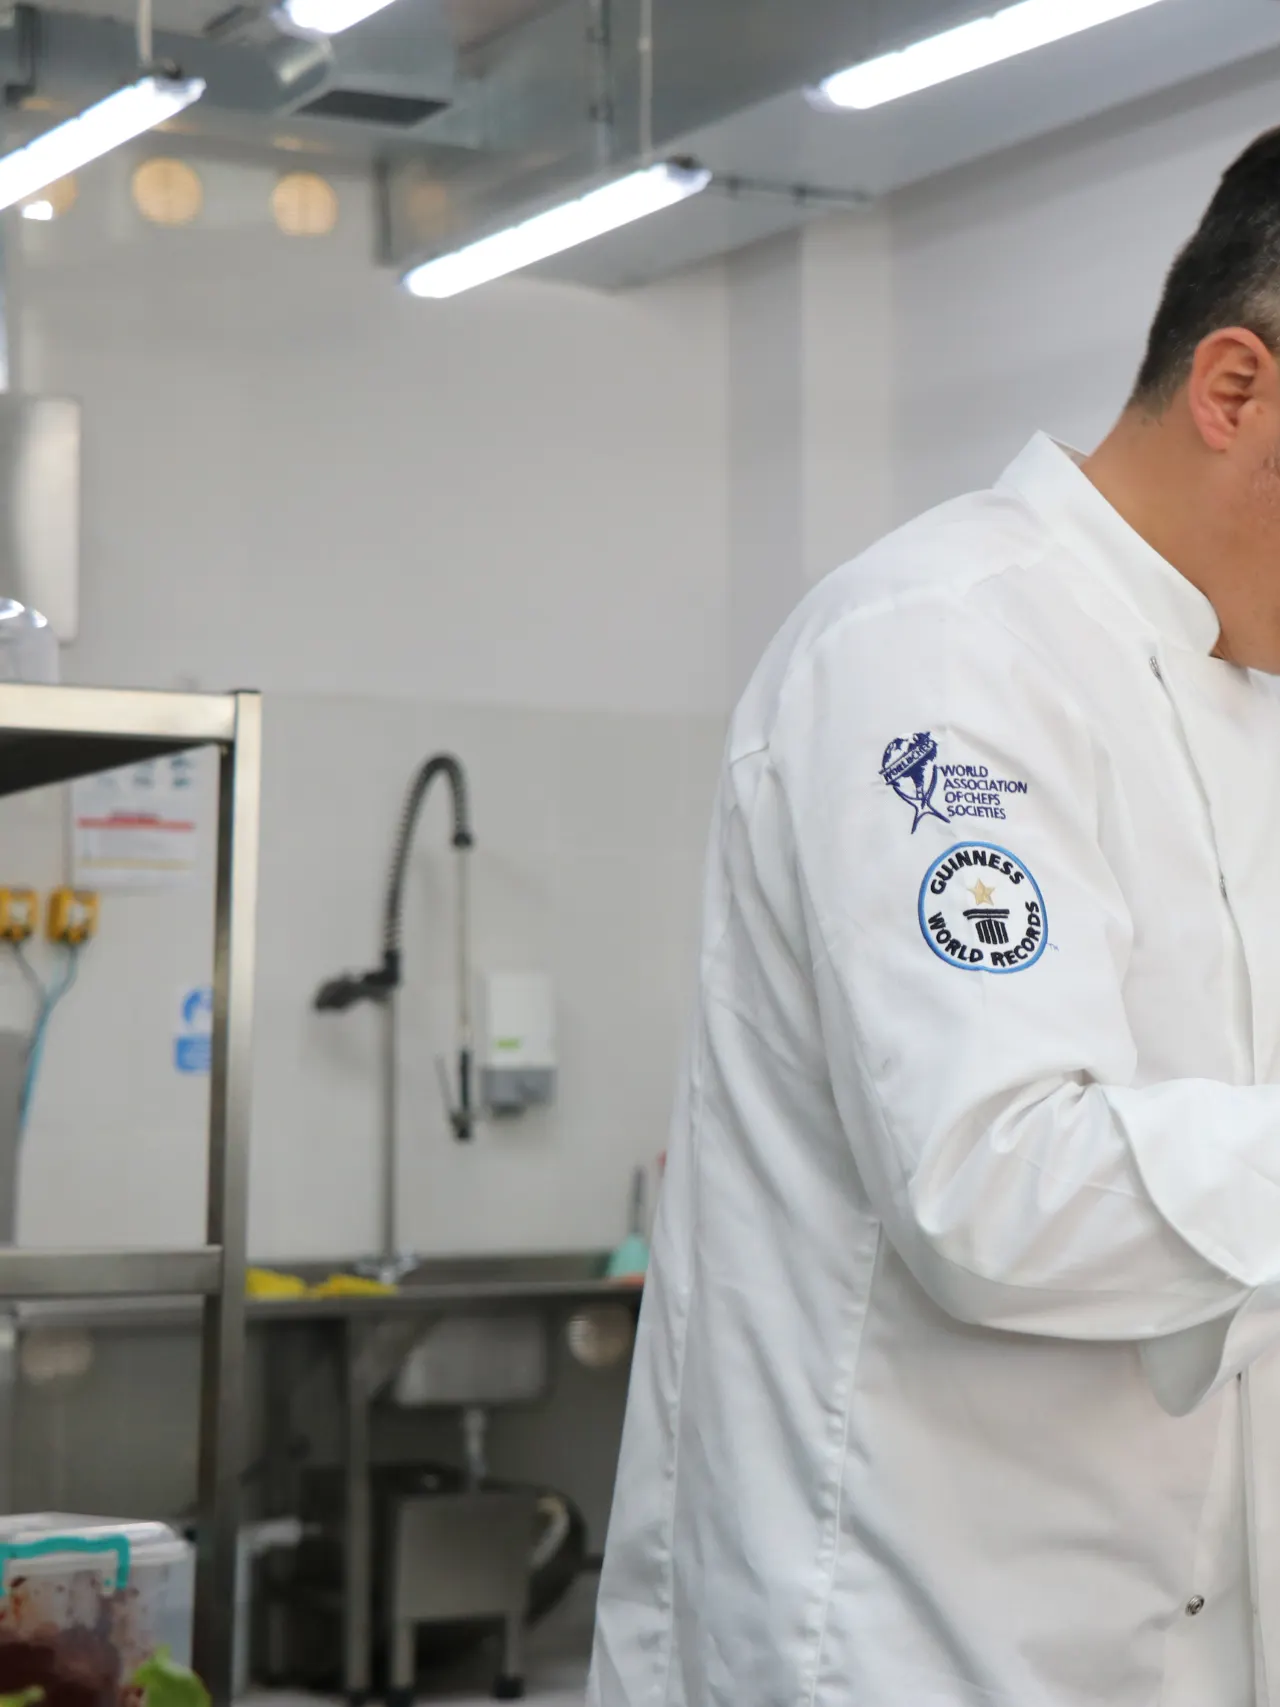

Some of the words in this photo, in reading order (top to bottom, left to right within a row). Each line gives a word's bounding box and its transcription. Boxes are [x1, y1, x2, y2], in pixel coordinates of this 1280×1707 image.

[940, 764, 988, 778] WORLD
[943, 778, 1028, 794] ASSOCIATION
[946, 804, 1006, 820] SOCIETIES
[930, 850, 1025, 895] GUINNESS
[928, 911, 984, 964] WORLD
[991, 901, 1041, 967] RECORDS
